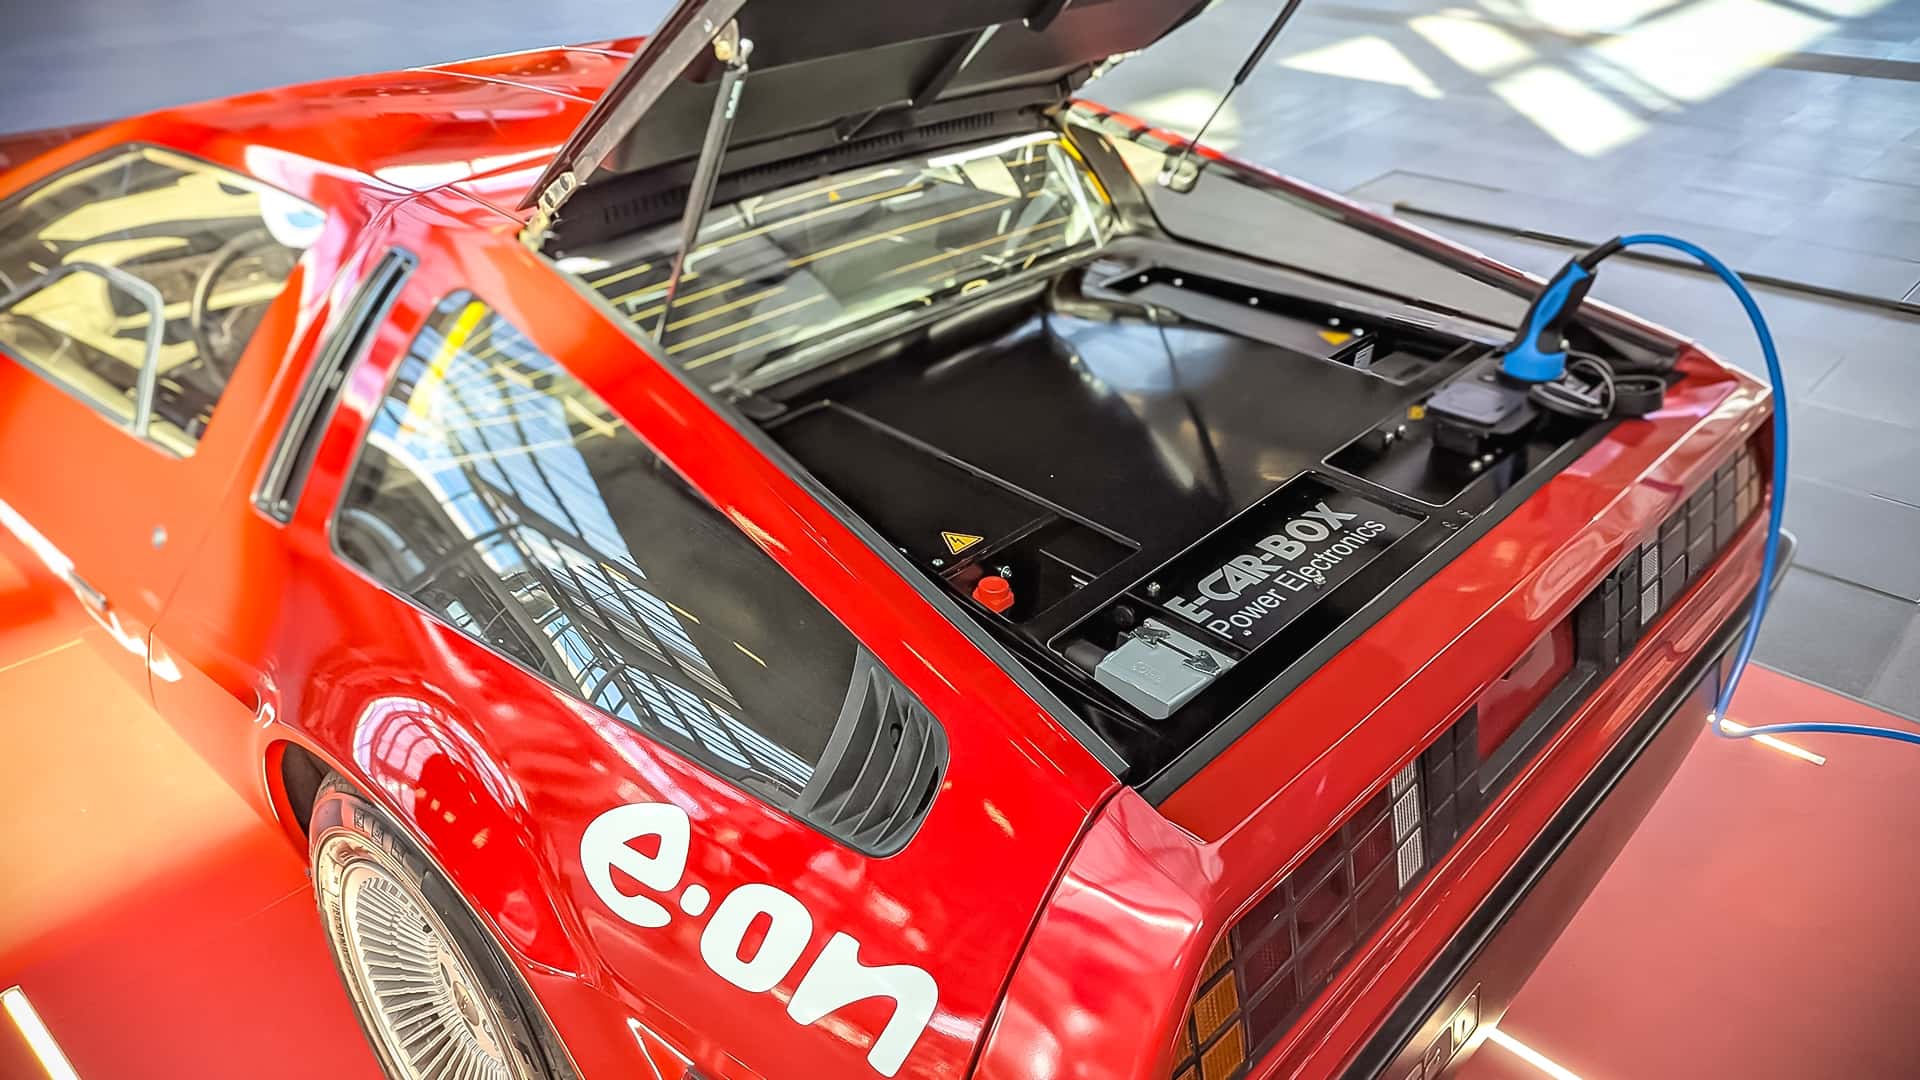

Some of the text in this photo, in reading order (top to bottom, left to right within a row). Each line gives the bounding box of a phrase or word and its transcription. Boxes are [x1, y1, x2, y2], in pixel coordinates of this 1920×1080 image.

[1163, 501, 1358, 625] E-CAR-BOX
[1206, 519, 1387, 640] Power Electronics
